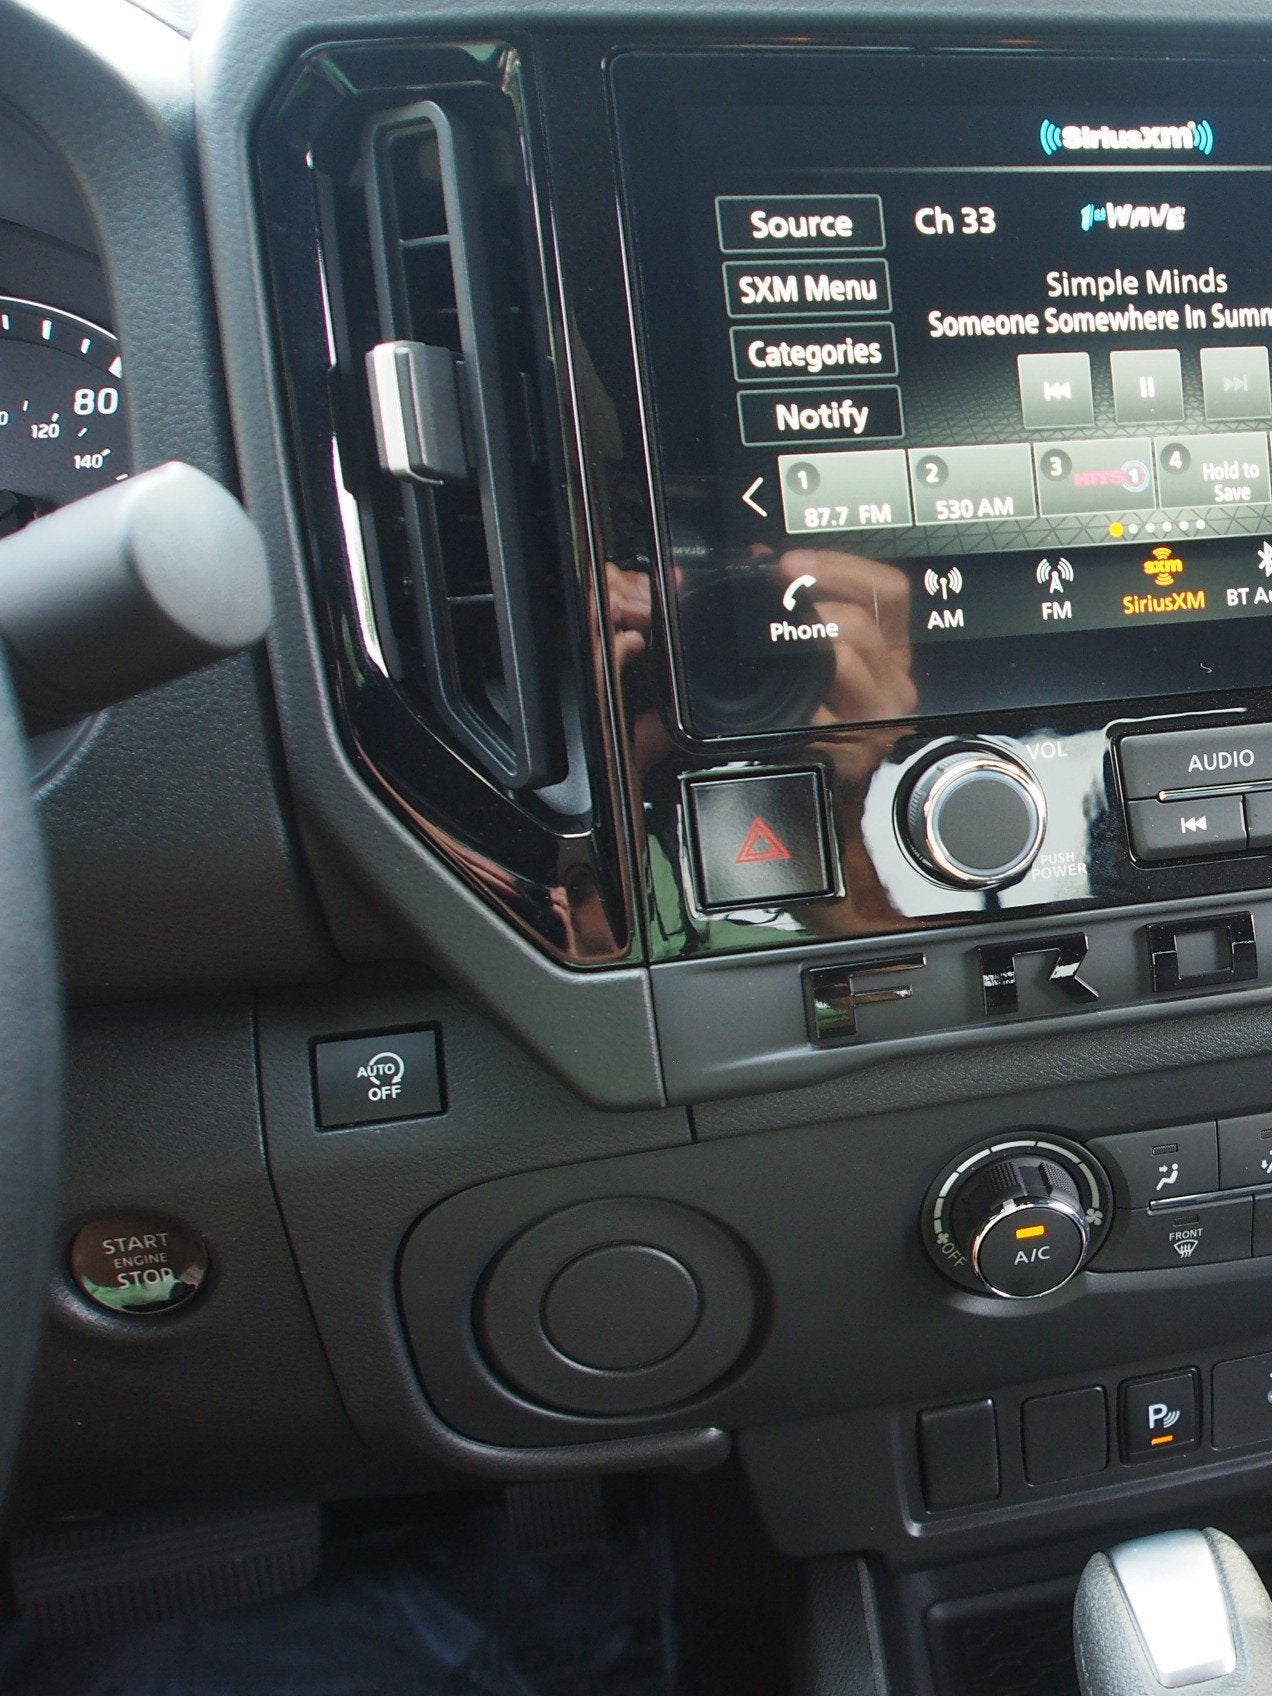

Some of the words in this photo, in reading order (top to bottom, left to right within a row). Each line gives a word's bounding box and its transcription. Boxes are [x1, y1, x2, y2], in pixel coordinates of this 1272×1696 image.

[750, 210, 853, 239] Source
[914, 206, 954, 235] Ch
[961, 206, 997, 235] 33
[738, 275, 799, 304] SXM
[804, 274, 878, 301] Menu
[1046, 270, 1139, 301] Simple
[1145, 267, 1229, 297] Minds
[928, 310, 1040, 338] Someone
[1044, 305, 1179, 335] Somewhere
[1185, 303, 1207, 329] In
[748, 338, 882, 373] Categories
[73, 388, 118, 416] 80
[775, 399, 869, 434] Notify
[31, 423, 60, 439] 120
[73, 454, 103, 469] 140
[1050, 456, 1063, 477] 3
[1169, 451, 1183, 470] 4
[798, 470, 808, 490] 1
[925, 462, 939, 483] 2
[1202, 461, 1239, 482] Hold
[1242, 462, 1260, 479] to
[1214, 483, 1251, 502] Save
[804, 505, 849, 528] 87.7
[859, 503, 892, 524] FM
[935, 498, 974, 520] 530
[978, 496, 1014, 517] AM
[1143, 557, 1184, 575] sxm
[1123, 591, 1206, 615] SiriusXM
[1226, 587, 1251, 607] BT
[927, 608, 965, 629] AM
[1042, 600, 1072, 620] FM
[770, 621, 839, 642] Phone
[1026, 741, 1069, 760] VOL
[1188, 749, 1255, 773] AUDIO
[1040, 852, 1075, 866] PUSH
[1031, 863, 1088, 881] POWER
[356, 1062, 396, 1078] AUTO
[368, 1085, 402, 1101] OFF
[102, 1232, 168, 1255] START
[1169, 1227, 1203, 1242] FRONT
[113, 1252, 168, 1269] ENGINE
[941, 1242, 967, 1268] OFF
[1014, 1245, 1051, 1266] A/C
[117, 1267, 173, 1289] STOP
